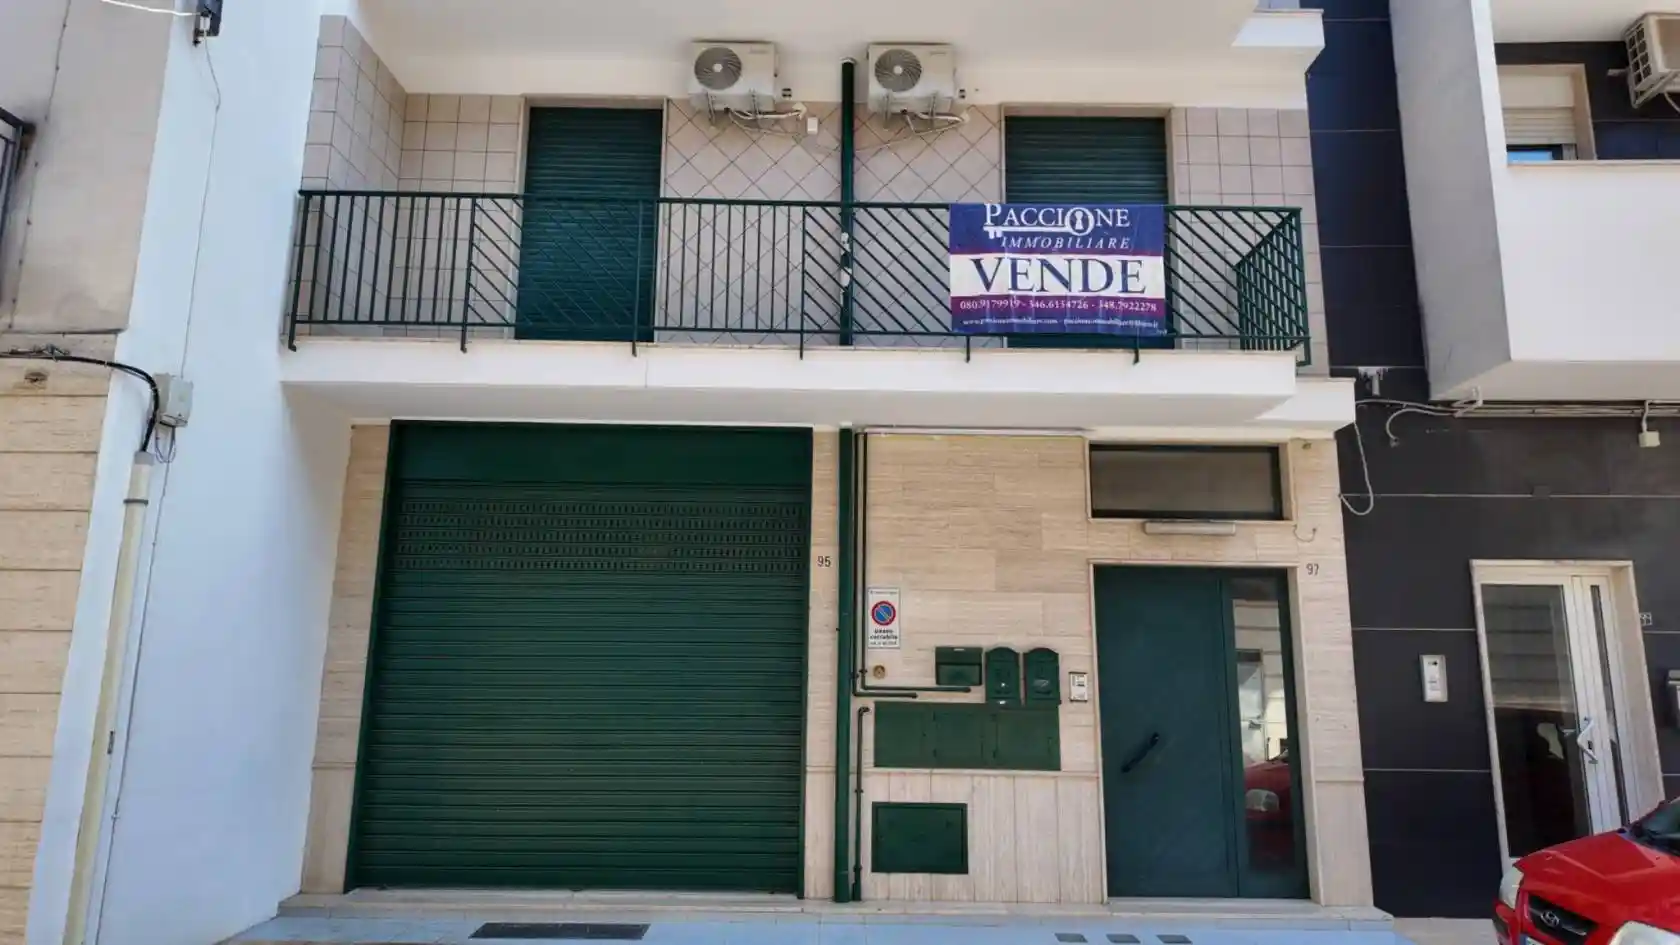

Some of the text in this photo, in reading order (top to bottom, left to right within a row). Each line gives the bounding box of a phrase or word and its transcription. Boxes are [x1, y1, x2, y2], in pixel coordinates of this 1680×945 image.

[984, 203, 1131, 235] PACCIONE
[1001, 236, 1131, 249] IMMOBILIARE
[970, 257, 1146, 294] VENDE
[817, 555, 831, 568] 95
[1306, 563, 1319, 576] 97
